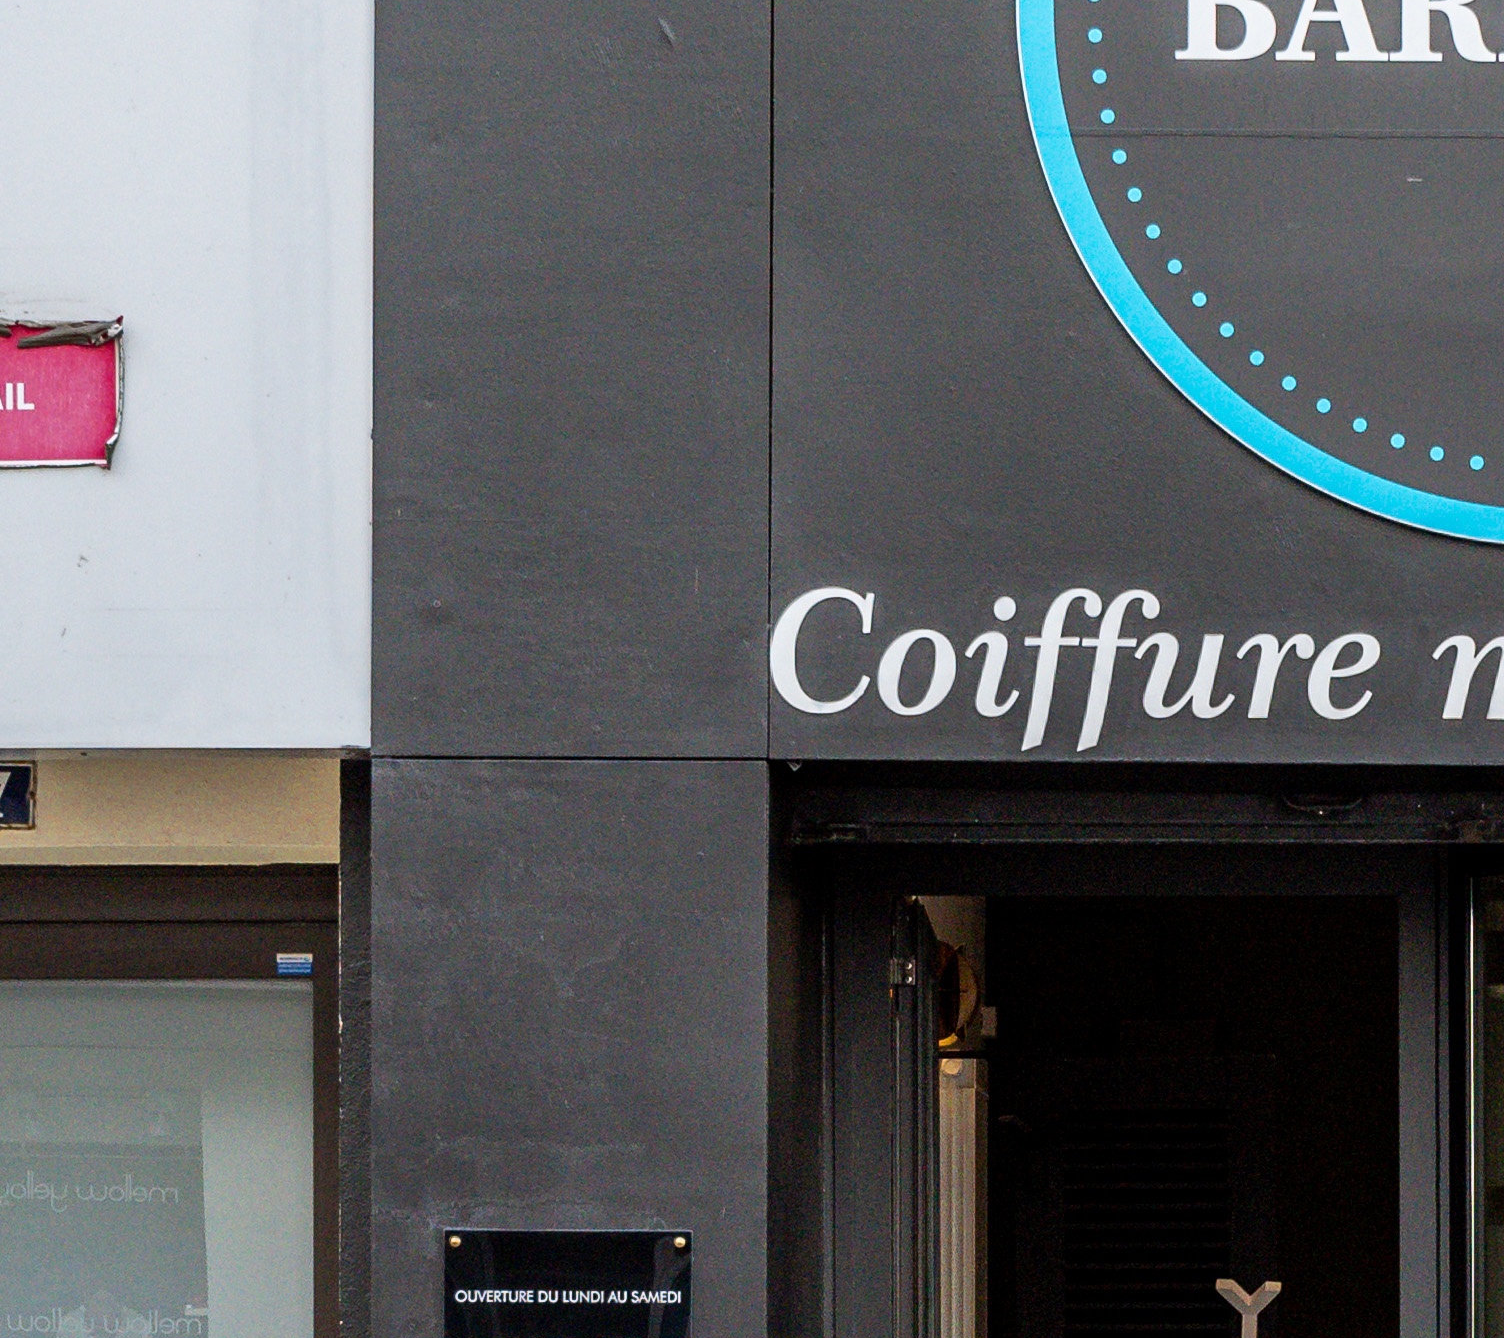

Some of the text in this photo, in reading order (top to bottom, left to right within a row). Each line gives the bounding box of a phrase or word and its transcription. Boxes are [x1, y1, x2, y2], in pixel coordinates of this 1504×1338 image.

[769, 586, 1381, 752] Coiffure
[454, 1289, 682, 1304] OUVERTURE DU LUNDI AU SAMEDI
